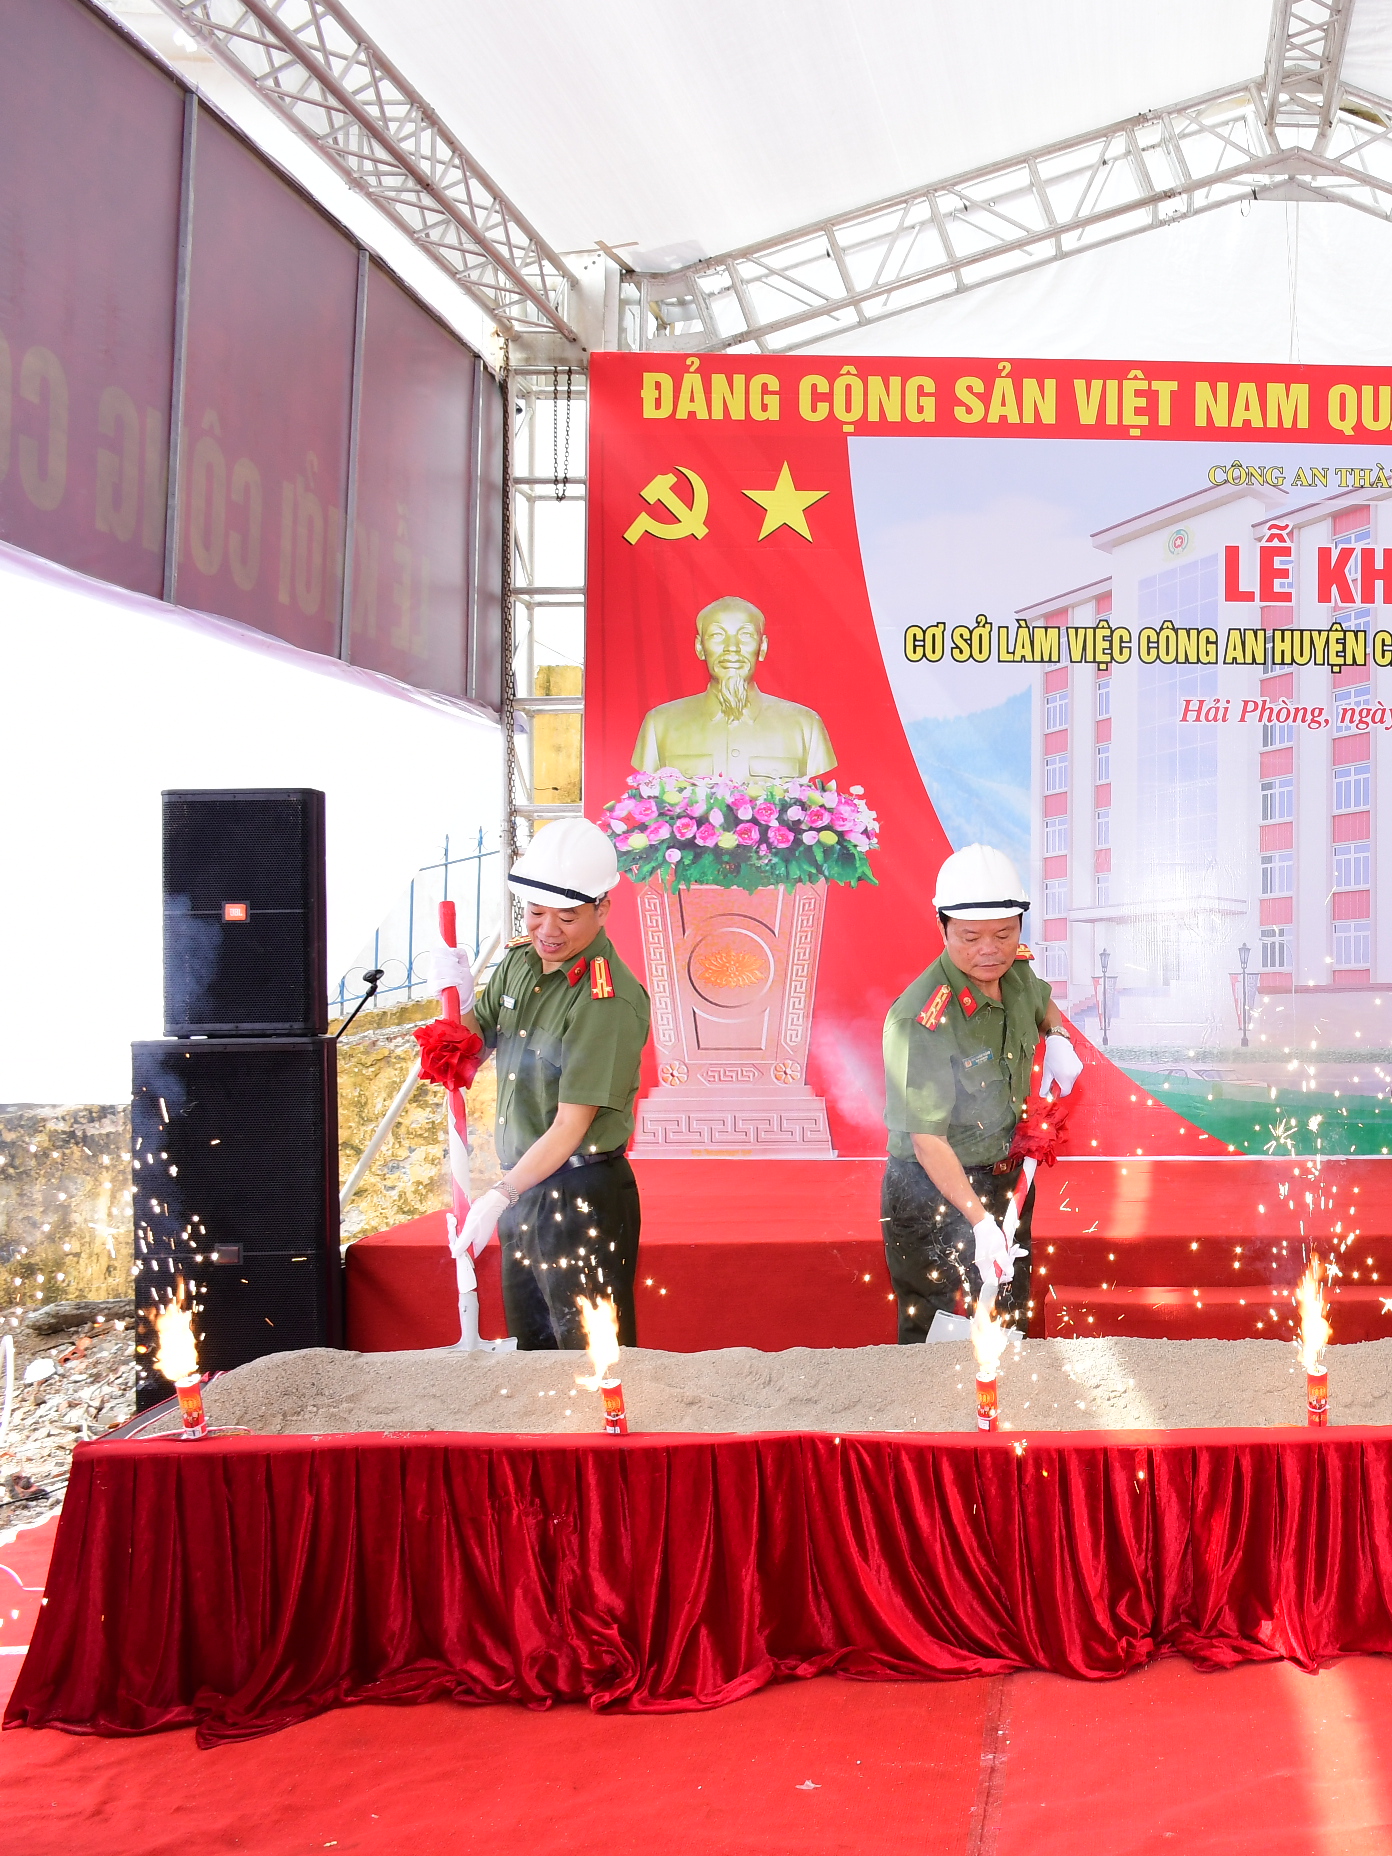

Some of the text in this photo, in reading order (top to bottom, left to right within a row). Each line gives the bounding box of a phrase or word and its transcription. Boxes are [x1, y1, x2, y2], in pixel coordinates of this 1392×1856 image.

[640, 357, 780, 422] ĐẢNG
[800, 366, 936, 432] CỘNG
[955, 362, 1057, 424] SẢN
[1076, 370, 1180, 437] VIỆT
[1196, 382, 1310, 430] NAM
[1208, 461, 1284, 487] CÔNG
[1291, 467, 1329, 488] AN
[1225, 523, 1294, 604] LỄ
[905, 621, 945, 663] CƠ
[951, 614, 992, 663] SỞ
[998, 618, 1060, 664] LÀM
[1067, 624, 1131, 671] VIỆC
[1138, 623, 1218, 665] CÔNG
[1223, 629, 1267, 666] AN
[1272, 624, 1366, 673] HUYỆN
[1180, 698, 1233, 724] Hải
[1239, 700, 1330, 730] Phòng,
